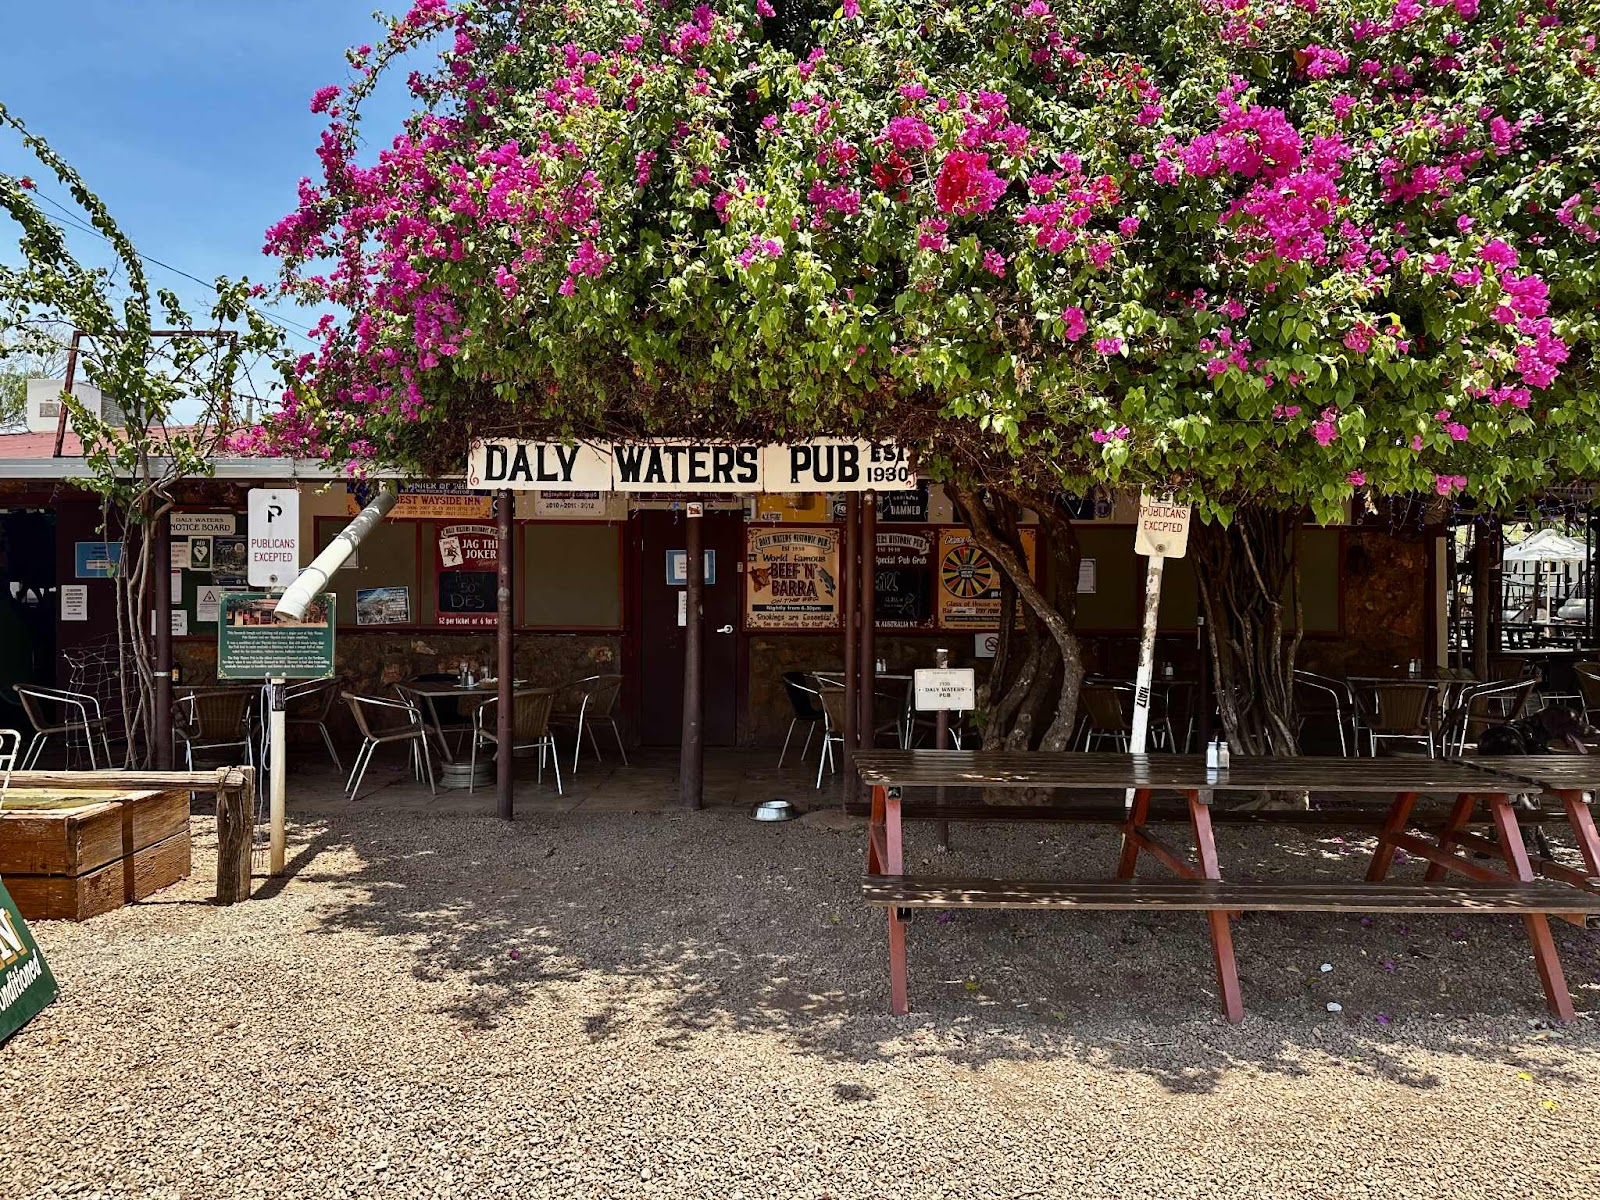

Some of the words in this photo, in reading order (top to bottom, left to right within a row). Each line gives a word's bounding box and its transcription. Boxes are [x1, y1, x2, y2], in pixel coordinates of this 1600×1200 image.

[484, 445, 583, 482] DALY
[614, 445, 758, 483] WATERS
[791, 445, 860, 483] PUB
[866, 467, 908, 483] 1930
[421, 495, 461, 505] WAYSIDE
[464, 496, 481, 505] INN
[890, 505, 921, 515] DAMNED
[1142, 506, 1187, 519] PUBLICANS
[170, 524, 200, 532] NOTICE
[202, 524, 232, 532] BOARD
[1144, 520, 1183, 533] EXCEPTED
[251, 538, 296, 549] PUBLICANS
[461, 539, 479, 549] JAG
[254, 552, 293, 562] EXCEPTED
[465, 549, 497, 559] JOKER
[762, 554, 788, 562] World
[898, 556, 910, 565] Pub
[912, 556, 927, 565] Grub
[771, 580, 820, 597] BARRA
[963, 600, 971, 608] of
[756, 613, 785, 621] Bookings
[802, 613, 832, 621] Essential
[0, 949, 42, 1011] onditioned
